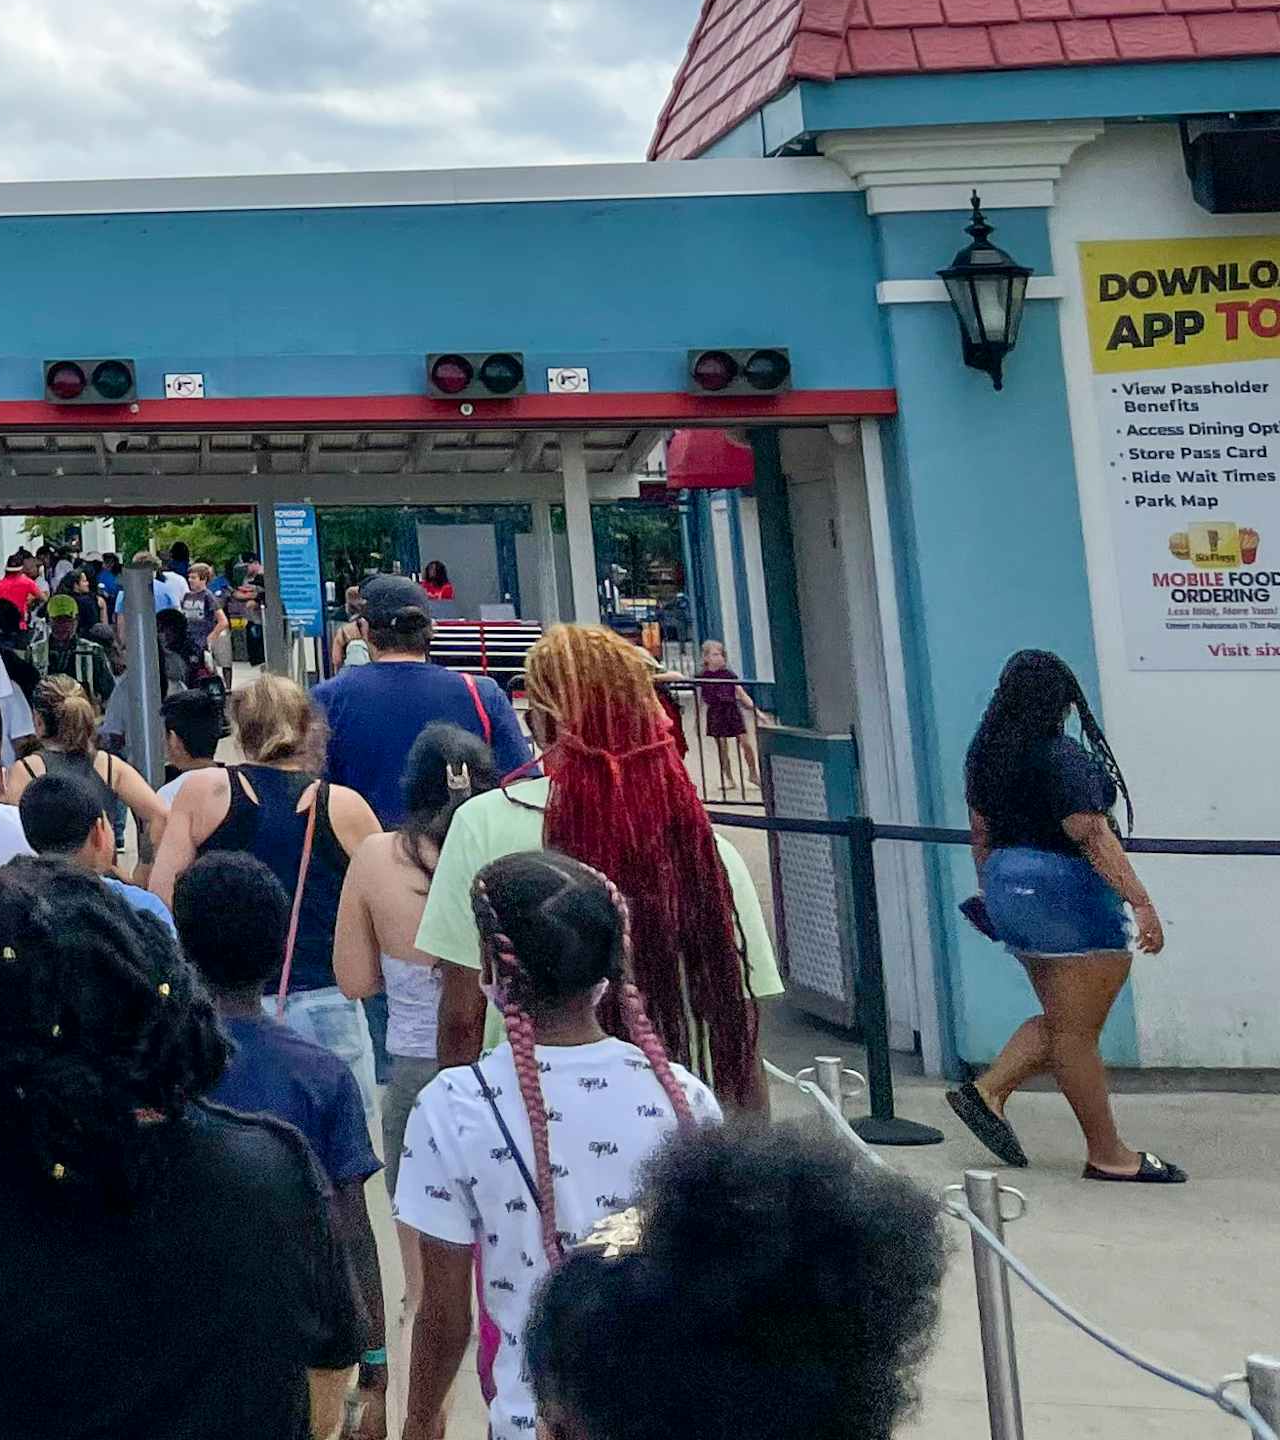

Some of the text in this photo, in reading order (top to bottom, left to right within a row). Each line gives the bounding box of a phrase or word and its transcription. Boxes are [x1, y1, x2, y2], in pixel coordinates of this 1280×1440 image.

[1100, 260, 1280, 302] DOWNLO
[1106, 310, 1205, 351] APP
[1122, 381, 1269, 395] View Passholder
[1124, 399, 1199, 413] Benefits
[1127, 424, 1184, 436] Access
[1189, 421, 1244, 437] Dining
[1129, 445, 1267, 460] Store Pass Card
[1132, 469, 1276, 483] Ride Wait Times
[1135, 494, 1218, 509] Park Map
[1152, 572, 1280, 587] MOBILE FOOD
[1171, 588, 1270, 603] ORDERING
[1208, 643, 1250, 657] Visit
